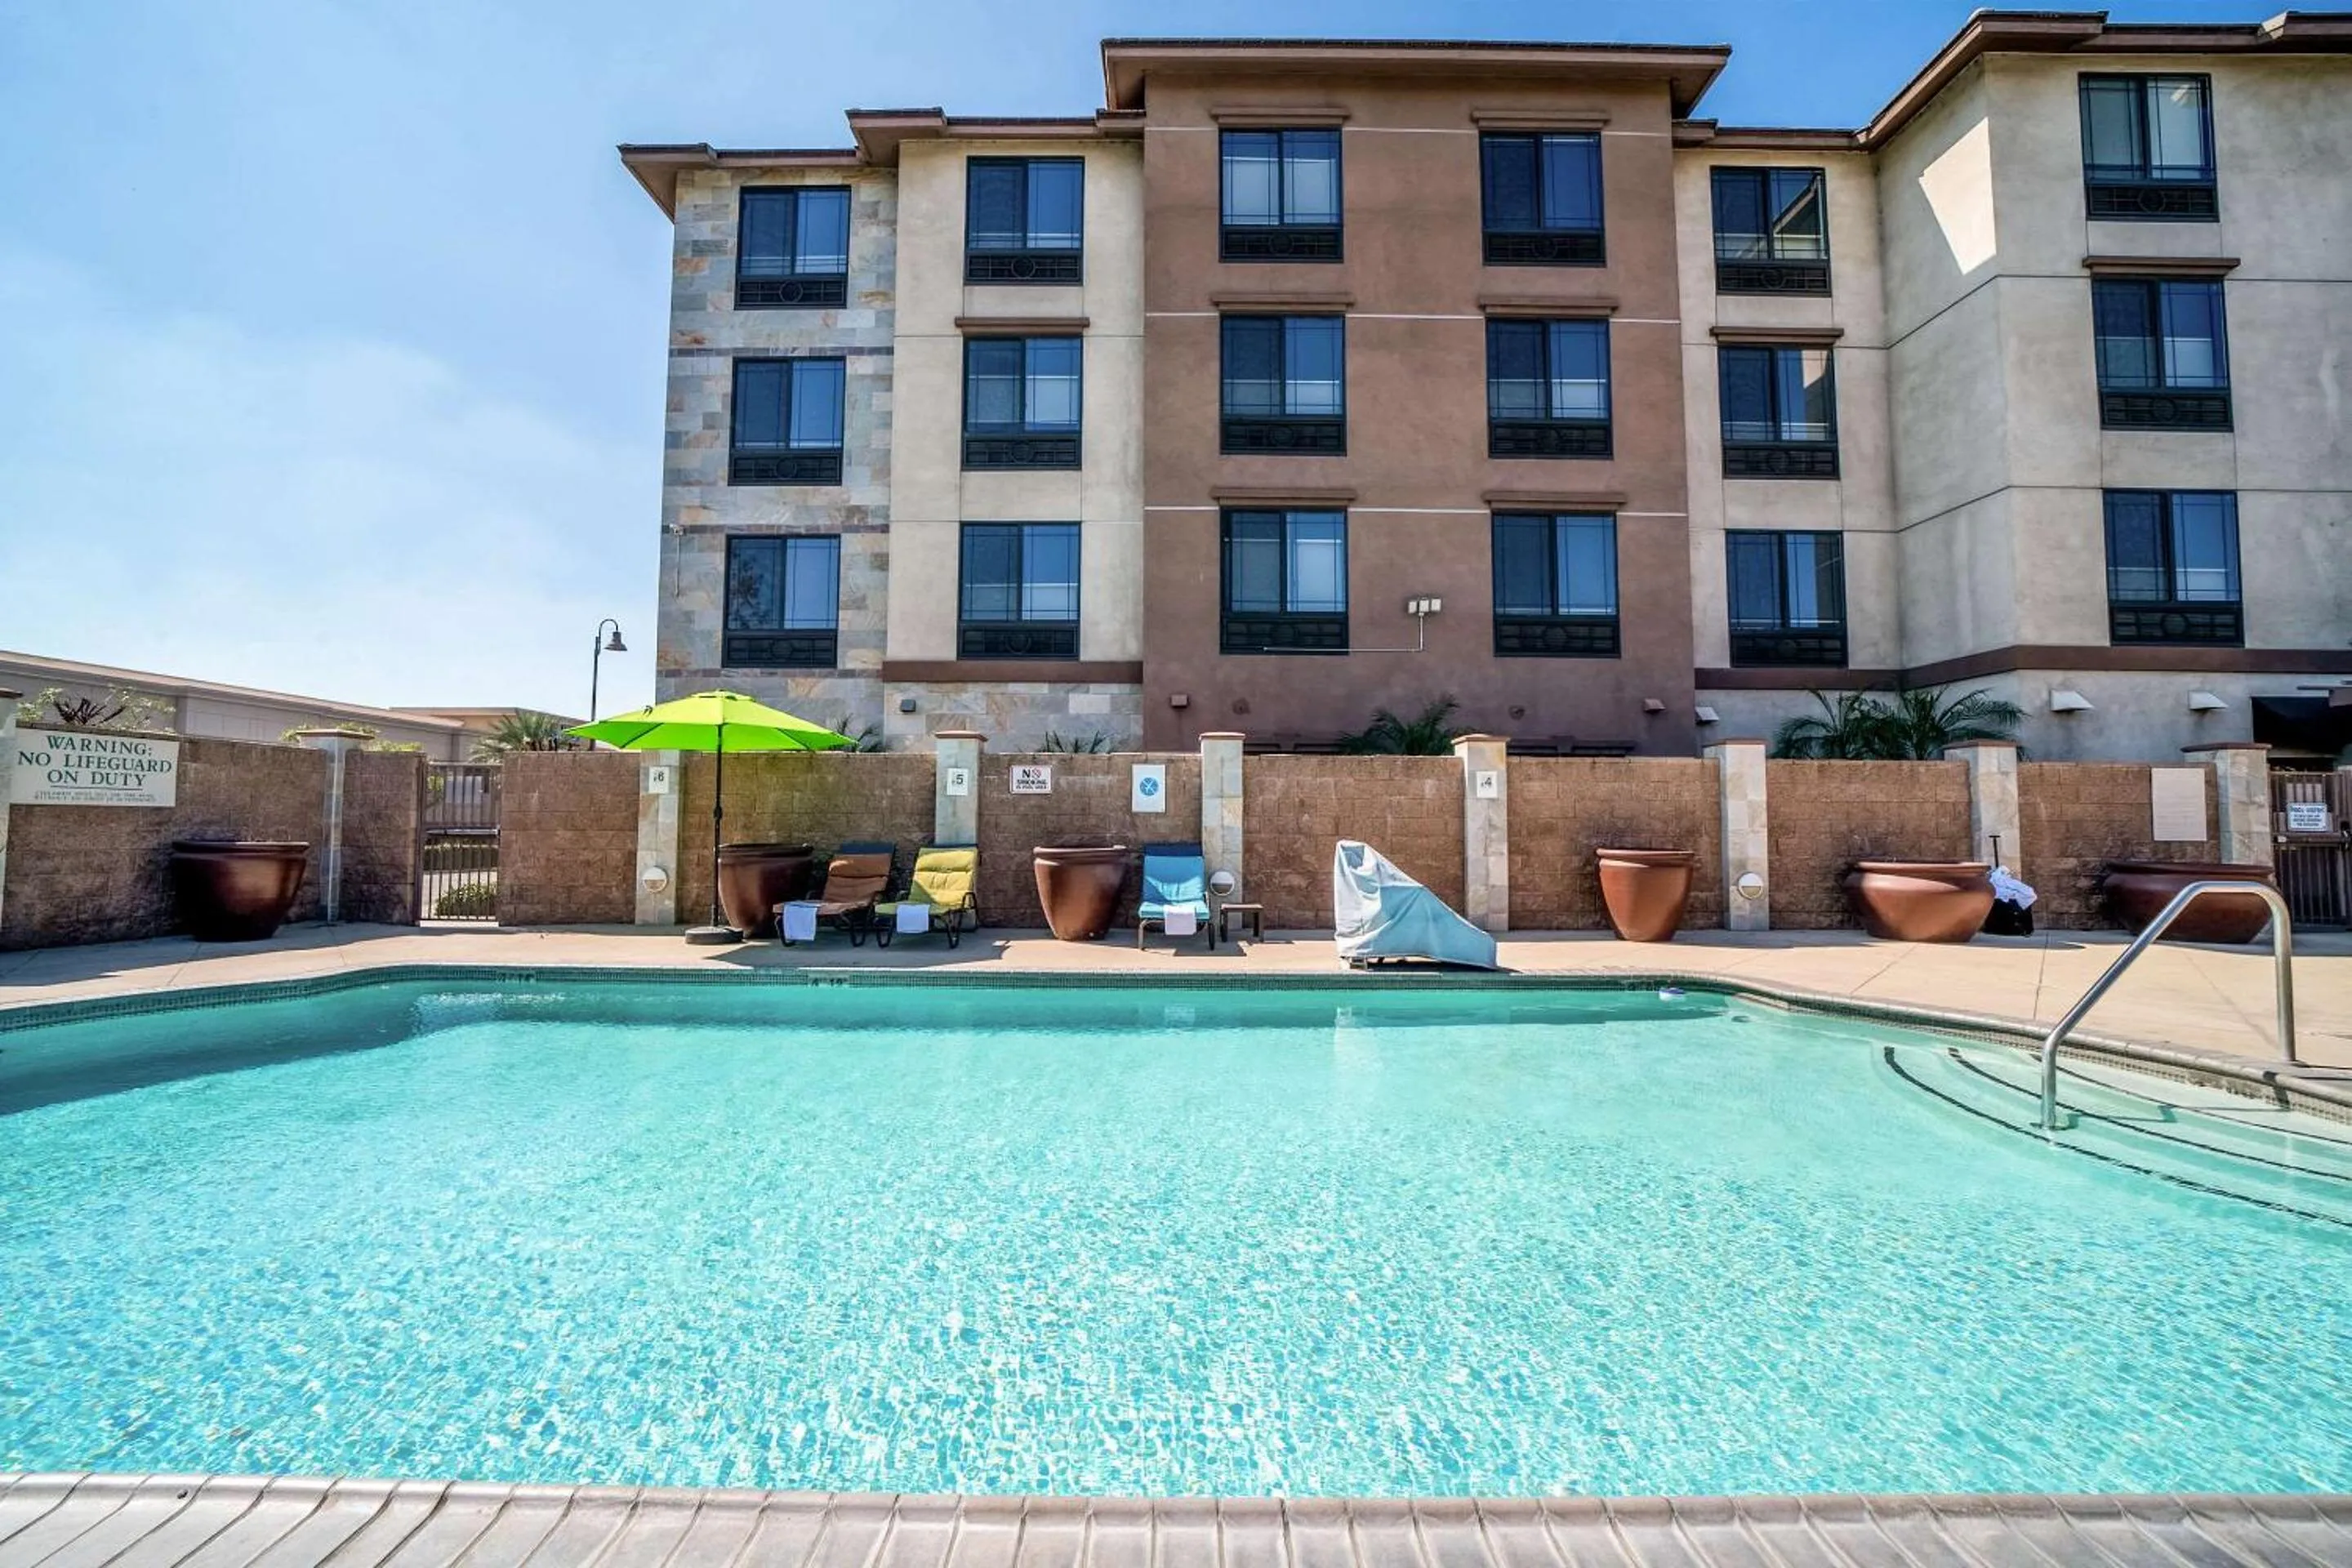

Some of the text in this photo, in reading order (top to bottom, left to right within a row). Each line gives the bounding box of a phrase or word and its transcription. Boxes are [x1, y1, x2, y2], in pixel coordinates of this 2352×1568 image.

[18, 751, 172, 773] NO LIFEGUARD
[47, 769, 146, 786] ON DUTY
